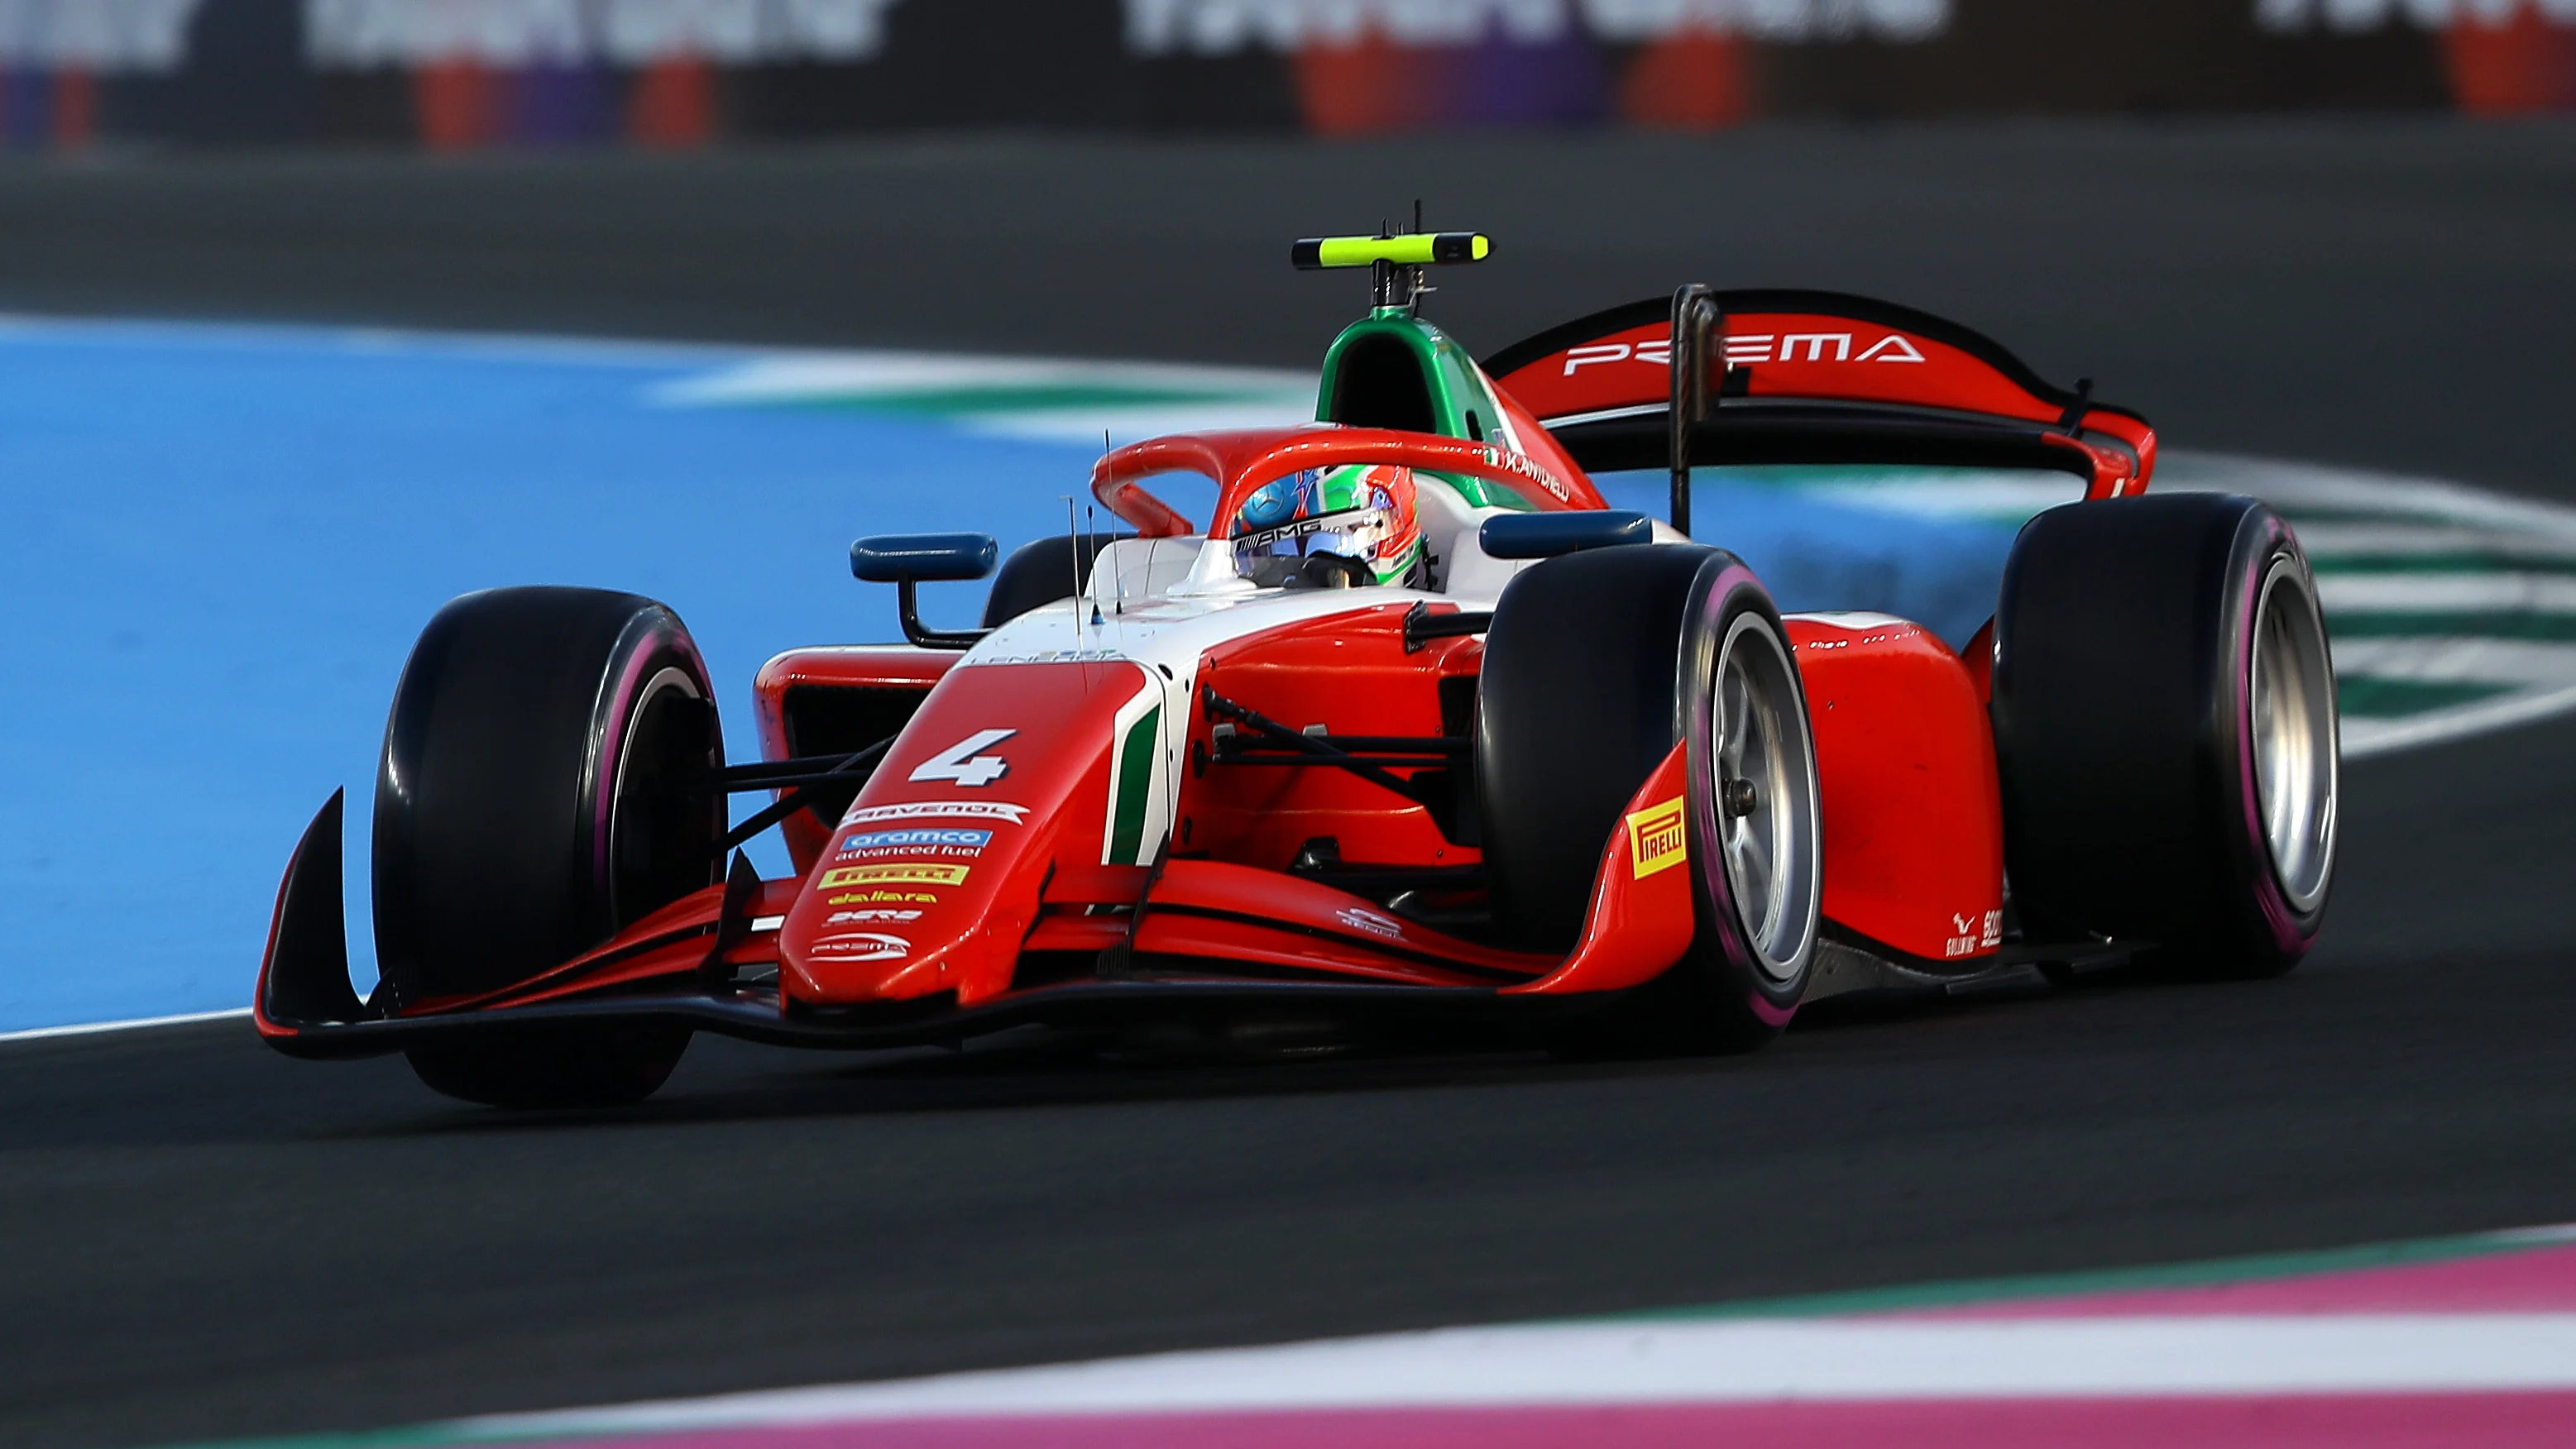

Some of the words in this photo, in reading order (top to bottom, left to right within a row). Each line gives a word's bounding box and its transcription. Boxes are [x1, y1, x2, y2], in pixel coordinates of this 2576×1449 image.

[1563, 332, 1926, 376] PREMA
[908, 729, 1017, 787] 4
[850, 830, 982, 846] aramco
[1636, 811, 1682, 863] PIRELLI
[835, 844, 938, 861] advanced
[941, 845, 982, 858] fuel
[831, 867, 956, 882] PIRELLI
[828, 890, 937, 905] dallara
